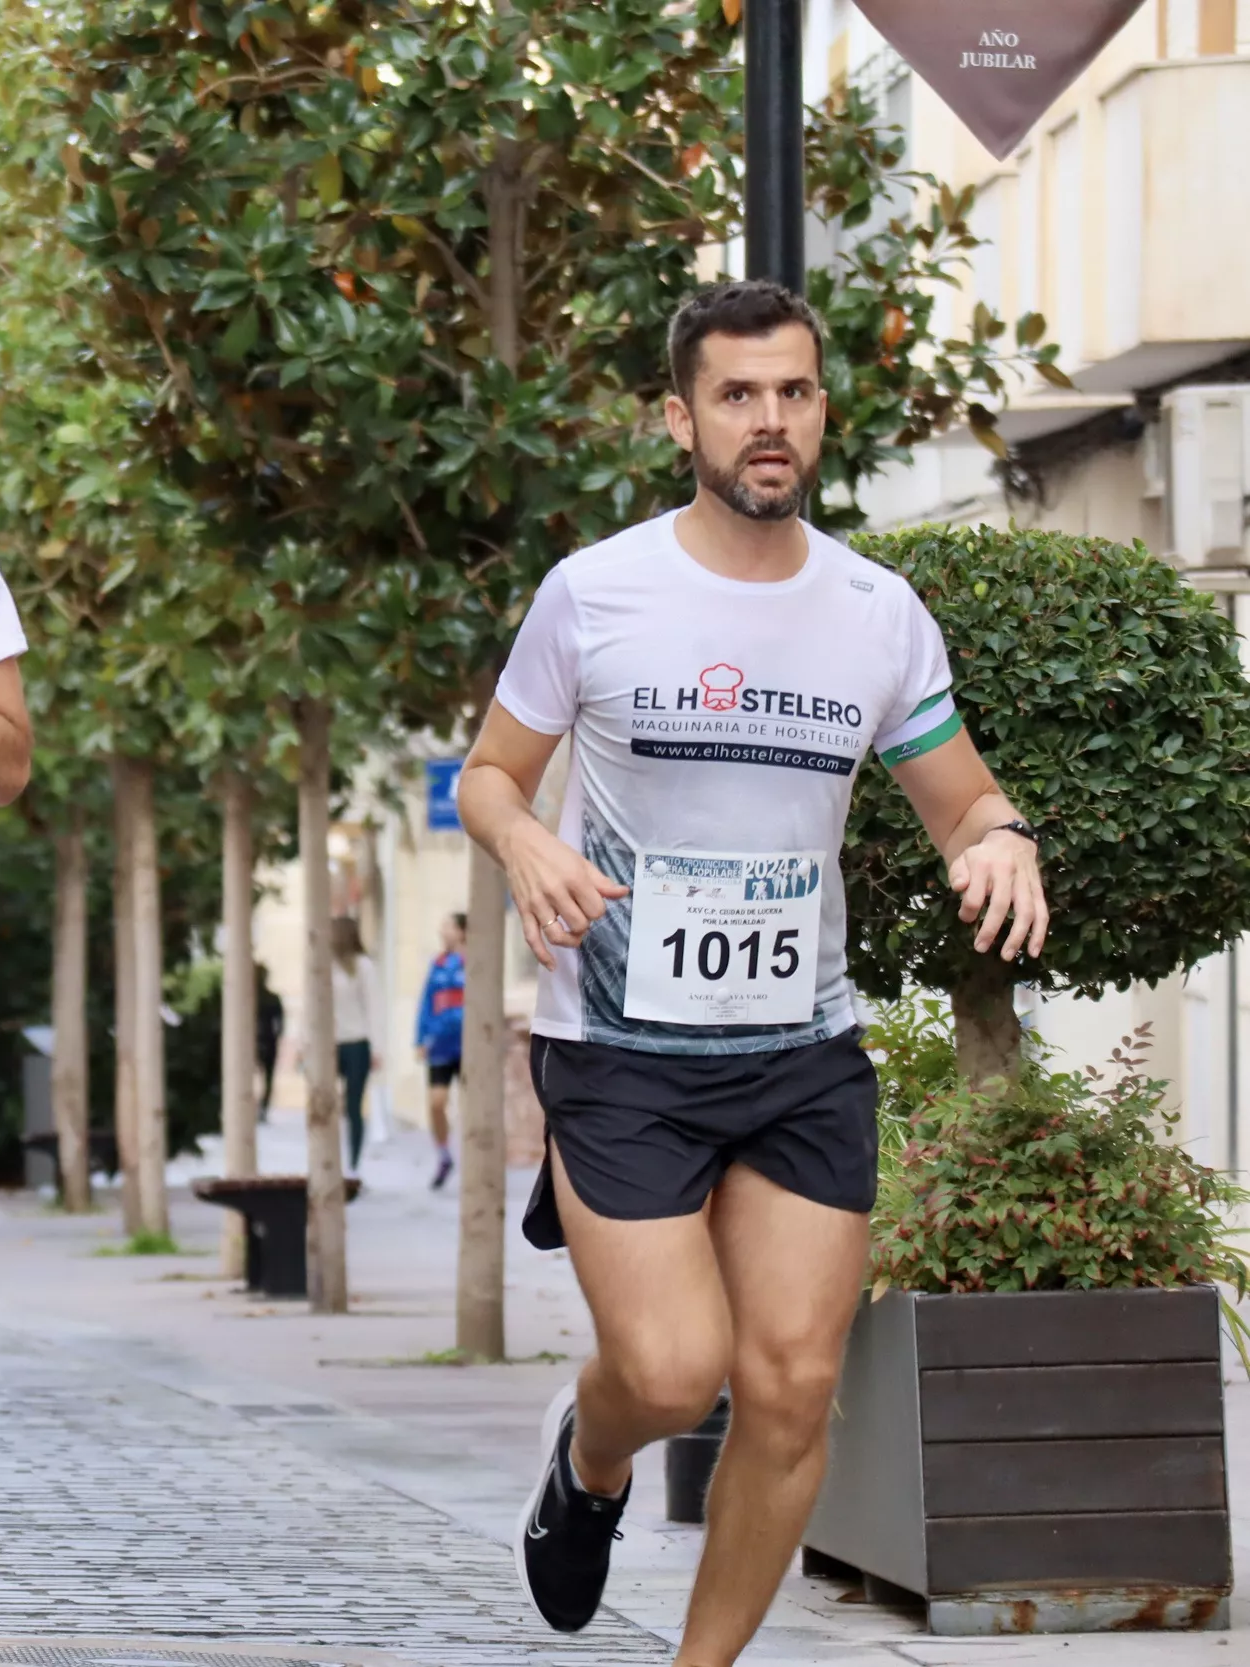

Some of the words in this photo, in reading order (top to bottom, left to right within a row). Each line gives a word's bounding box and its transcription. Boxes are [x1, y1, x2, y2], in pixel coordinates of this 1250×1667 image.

[978, 28, 1020, 48] AÑO
[959, 51, 1038, 70] JUBILAR
[632, 686, 667, 711] EL
[631, 718, 741, 734] MAQUINARIA
[748, 723, 768, 736] DE
[775, 725, 861, 749] HOSTELERÍA
[682, 858, 730, 870] PROVINCIAL
[692, 867, 743, 879] POPULARES
[743, 859, 789, 880] 2024
[687, 906, 703, 914] XXV
[719, 908, 746, 916] CIUDAD
[747, 908, 756, 916] DE
[757, 907, 783, 916] LUCENA
[702, 918, 717, 926] POR
[718, 918, 728, 926] LA
[730, 918, 766, 926] IGUALDAD
[662, 928, 800, 981] 1015
[746, 993, 768, 1001] VARO
